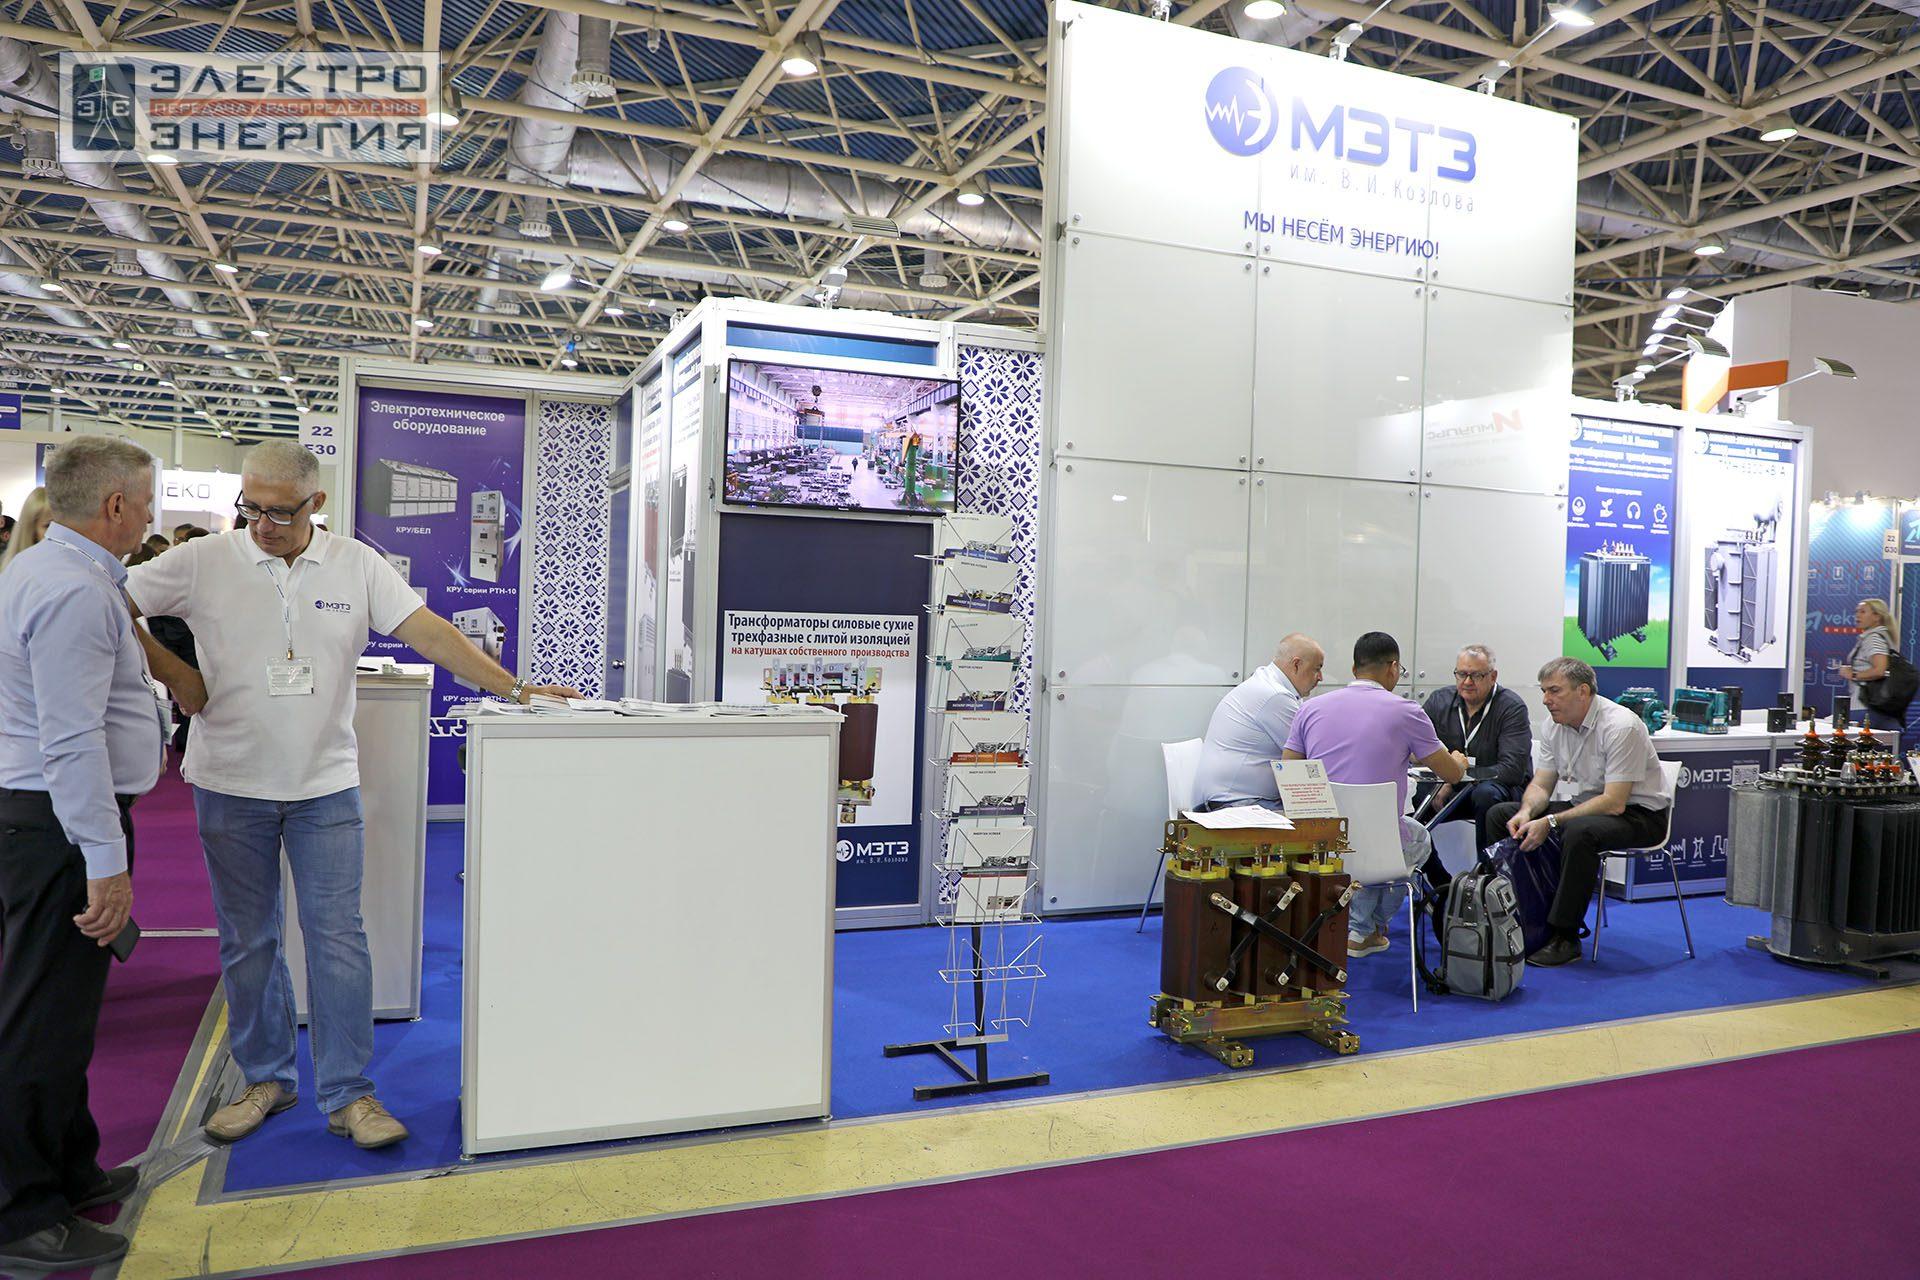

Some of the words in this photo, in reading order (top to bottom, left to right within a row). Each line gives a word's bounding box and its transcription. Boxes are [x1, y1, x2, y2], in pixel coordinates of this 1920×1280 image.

[1290, 96, 1477, 183] МЭТЗ
[1244, 210, 1275, 233] МЫ
[1283, 217, 1344, 244] НЕСЁМ
[1350, 228, 1440, 259] ЭНЕРГИЮ!
[370, 401, 506, 423] Электротехническое
[311, 426, 333, 437] 22
[393, 419, 487, 436] оборудование
[395, 525, 431, 535] КРУ/БЕЛ
[325, 602, 351, 611] МЭТЗ
[729, 613, 830, 631] Трансформаторы
[832, 619, 881, 630] силовые
[883, 620, 914, 633] сухие
[732, 629, 804, 645] трехфазные
[806, 634, 812, 643] с
[814, 632, 847, 643] литой
[850, 633, 911, 646] изоляцией
[731, 647, 742, 655] на
[744, 647, 787, 657] катушках
[789, 646, 847, 657] собственного
[850, 649, 910, 659] производства
[1692, 768, 1732, 783] МЭТЗ
[856, 841, 909, 856] МЭТЗ
